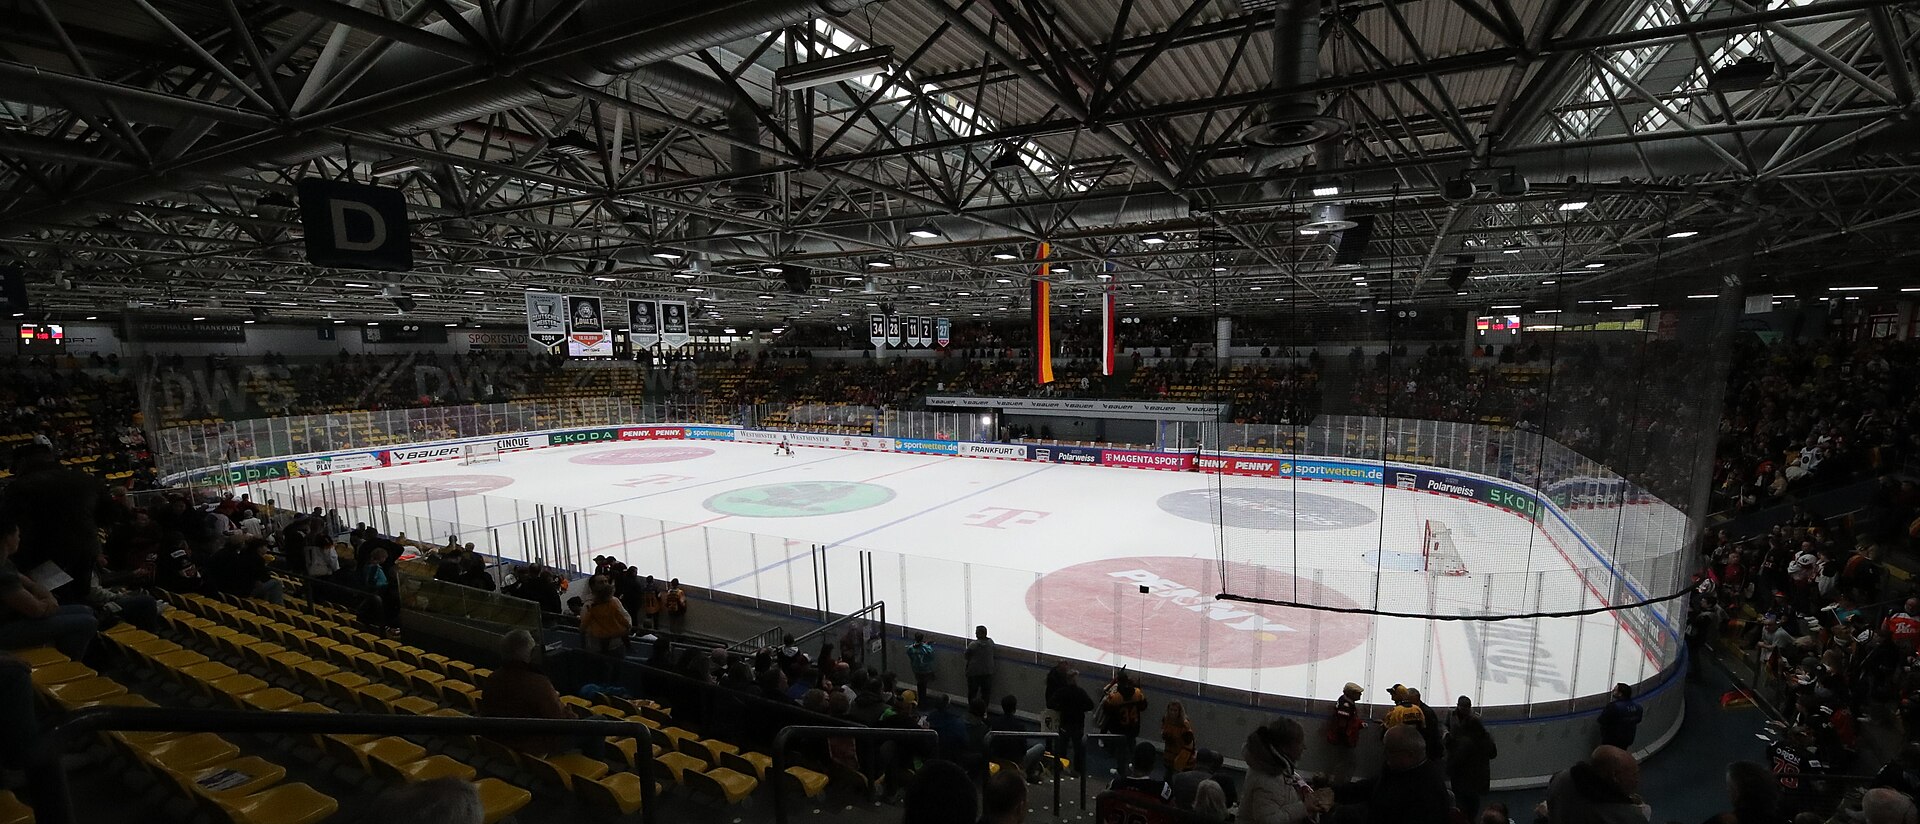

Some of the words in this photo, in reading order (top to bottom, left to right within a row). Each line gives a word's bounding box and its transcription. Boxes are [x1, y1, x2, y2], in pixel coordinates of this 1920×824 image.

[329, 199, 387, 251] D
[873, 323, 883, 335] 34
[890, 323, 898, 335] 28
[910, 324, 916, 335] 11
[924, 325, 928, 336] 2
[468, 333, 529, 344] SPORTSTADT
[693, 429, 734, 438] sportwetten.de
[497, 437, 529, 449] CINQUE
[904, 441, 958, 452] sportwetten.de
[971, 446, 1013, 455] FRANKFURT
[1058, 452, 1095, 463] Polarweiss
[1113, 454, 1153, 464] MAGENTA
[1155, 457, 1184, 466] SPORT
[1296, 464, 1383, 480] sportwetten.de
[1428, 479, 1475, 497] Polarweiss
[1472, 609, 1571, 694] INQUE
